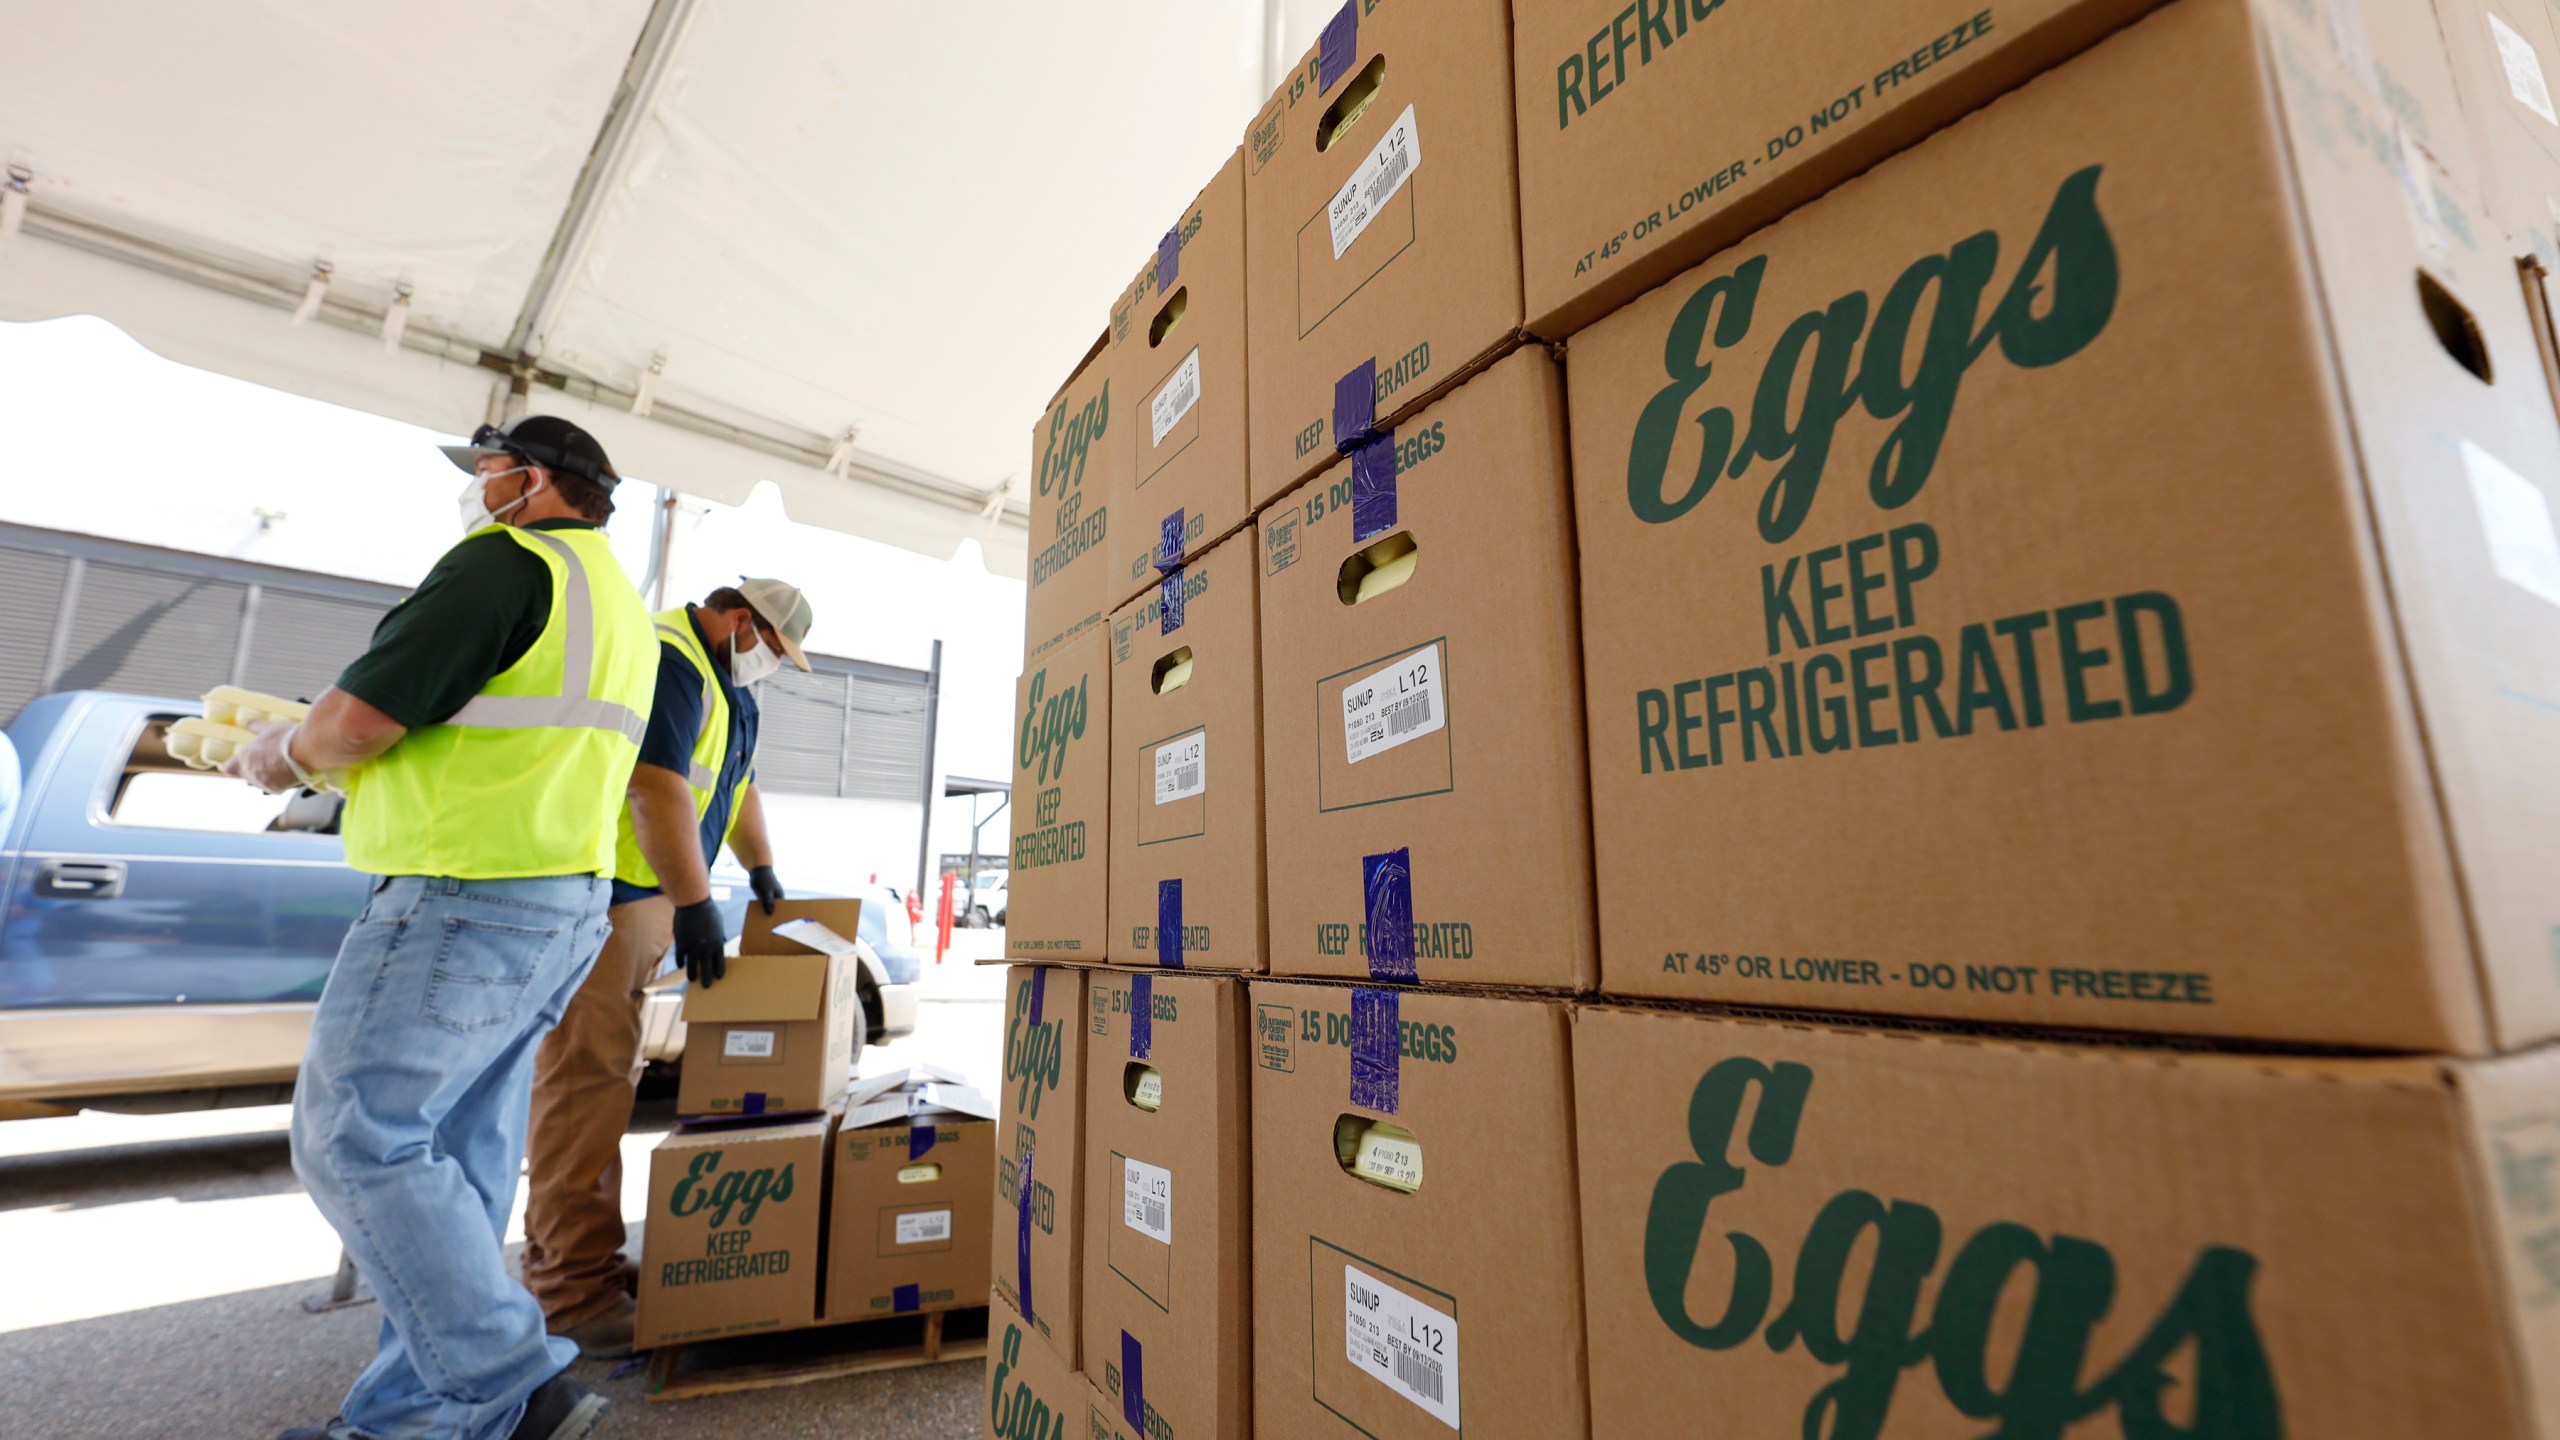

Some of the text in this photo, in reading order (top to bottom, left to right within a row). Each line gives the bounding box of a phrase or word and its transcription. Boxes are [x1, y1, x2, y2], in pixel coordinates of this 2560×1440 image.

[1288, 72, 1305, 109] 15
[1574, 251, 1596, 278] AT
[1633, 211, 1663, 241] OR
[1667, 159, 1747, 220] LOWER
[1767, 125, 1804, 161] DO
[1810, 85, 1866, 136] NOT
[1873, 7, 1996, 97] FREEZE
[1333, 183, 1357, 219] SUNUP
[1134, 280, 1145, 306] 15
[1627, 163, 2120, 544] Eggs
[1039, 378, 1110, 500] Eggs
[1295, 418, 1324, 460] KEEP
[1306, 492, 1325, 527] 15
[1395, 421, 1446, 477] EGGS
[1056, 491, 1082, 539] KEEP
[1033, 506, 1107, 589] REFRIGERATED
[1132, 552, 1149, 581] KEEP
[1760, 522, 1941, 656] KEEP
[1135, 606, 1146, 632] 15
[1347, 688, 1374, 714] SUNUP
[1399, 664, 1428, 694] L12
[1636, 591, 2195, 775] REFRIGERATED
[1020, 668, 1088, 786] Eggs
[1365, 712, 1375, 724] 213
[1381, 703, 1394, 718] BEST
[1394, 701, 1403, 712] BY
[1184, 743, 1199, 762] L12
[1036, 787, 1061, 829] KEEP
[1014, 820, 1086, 871] REFRIGERATED
[1132, 926, 1210, 952] KEEP RERATED
[1318, 923, 1474, 959] KEEP RERATED
[1663, 953, 1690, 975] AT
[1736, 957, 1775, 980] OR
[1779, 959, 1882, 986] LOWER
[1909, 963, 1958, 989] DO
[1966, 965, 2039, 994] NOT
[2050, 967, 2215, 1004] FREEZE
[1112, 989, 1121, 1013] 15
[1153, 994, 1177, 1022] EGGS
[1007, 979, 1063, 1121] Eggs
[1301, 1010, 1322, 1043] 15
[1398, 1021, 1457, 1064] EGGS
[670, 1150, 795, 1229] Eggs
[1151, 1177, 1166, 1198] L12
[1384, 1165, 1395, 1176] SEP
[706, 1230, 752, 1257] KEEP
[1644, 1056, 2291, 1440] Eggs
[662, 1250, 790, 1288] REFRIGERATED
[1350, 1282, 1380, 1313] SUNUP
[1410, 1315, 1443, 1356] L12
[1368, 1321, 1380, 1337] 213
[1387, 1333, 1402, 1351] BEST
[1403, 1341, 1411, 1356] BY
[992, 1323, 1064, 1440] Eggs
[1105, 1359, 1120, 1398] KEEP
